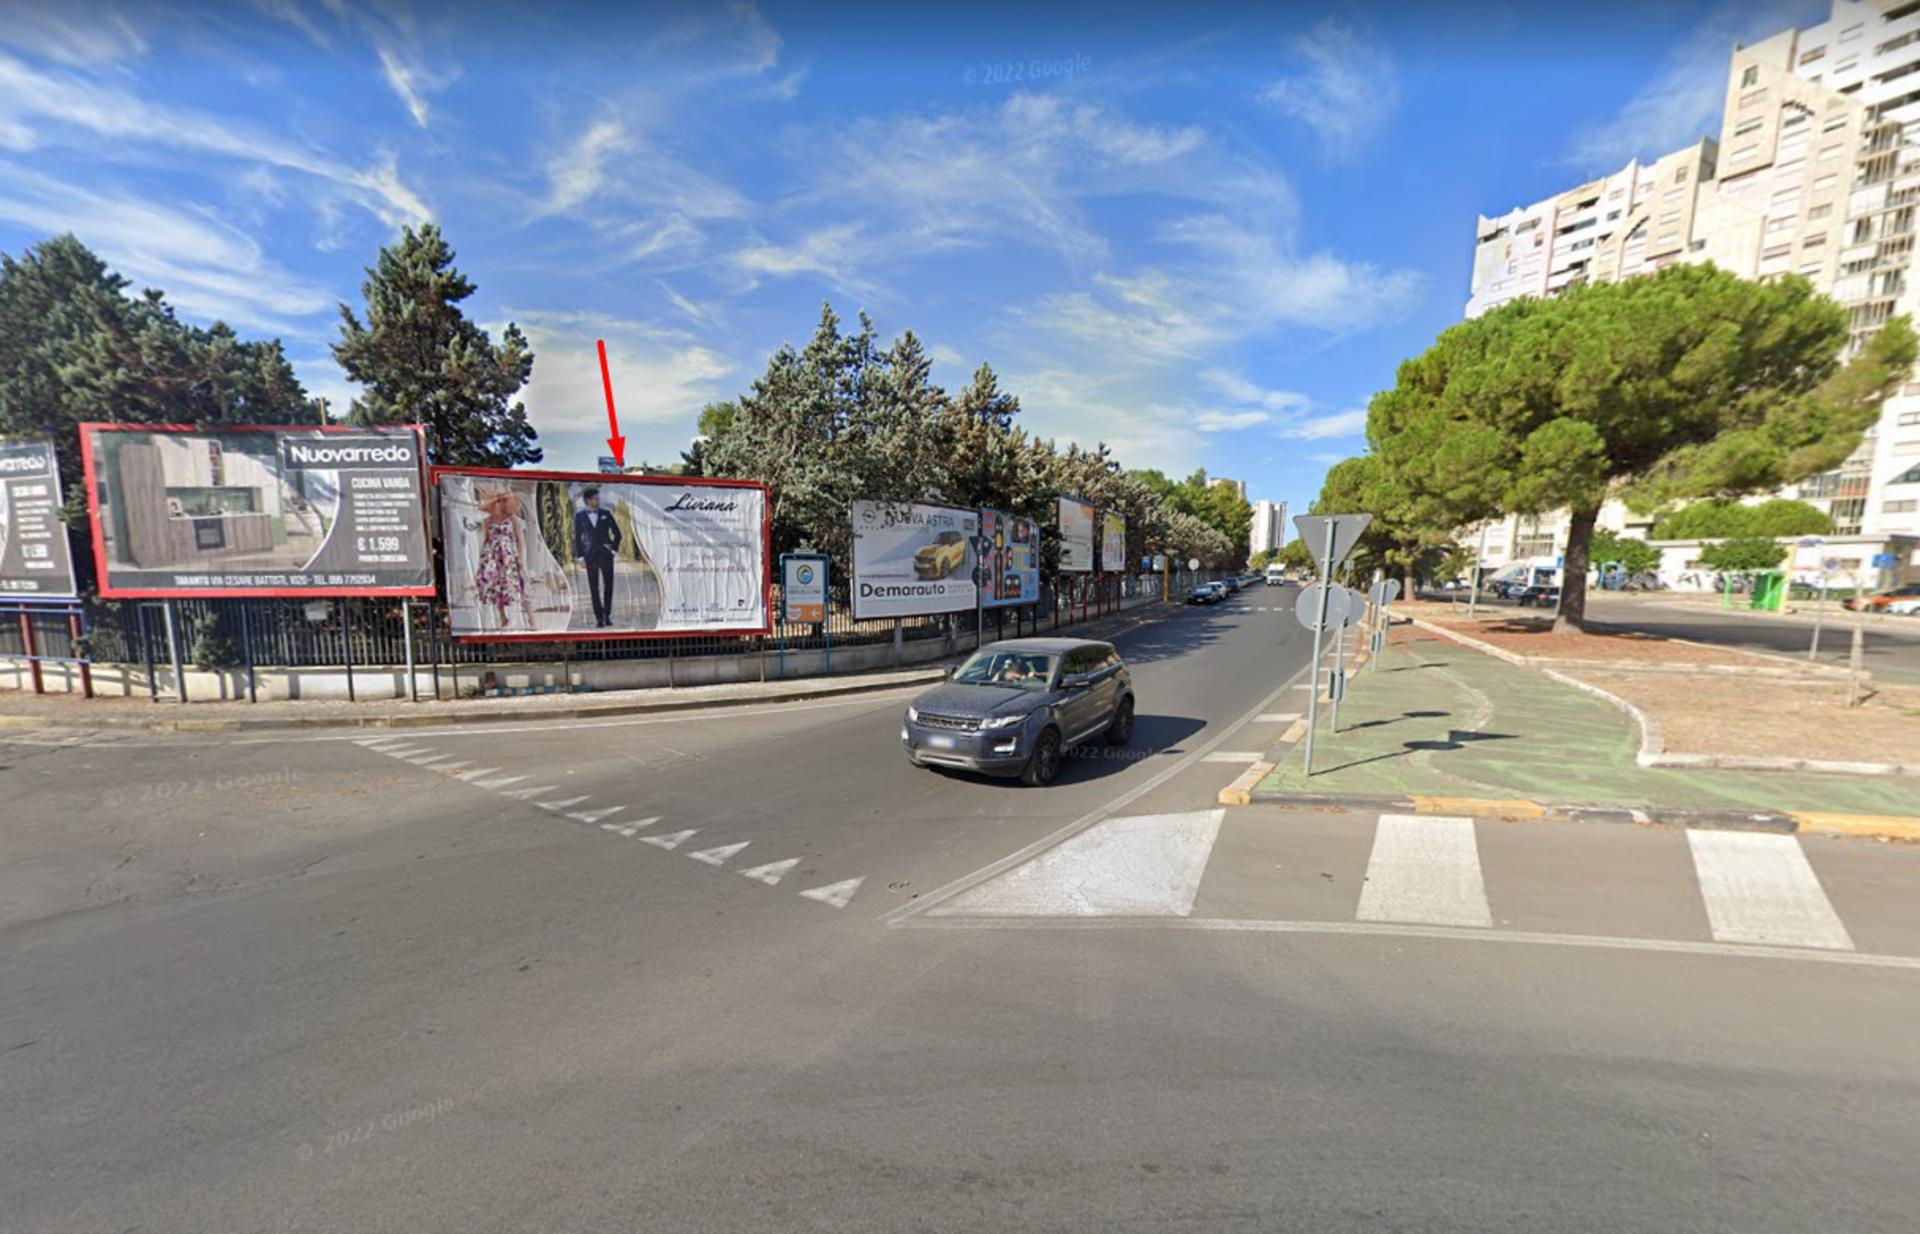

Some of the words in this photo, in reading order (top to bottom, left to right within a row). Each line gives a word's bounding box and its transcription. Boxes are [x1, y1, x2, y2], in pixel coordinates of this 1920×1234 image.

[290, 445, 411, 464] Nuovarredo
[0, 455, 46, 471] arredo
[664, 493, 738, 512] Liviana
[926, 513, 954, 527] ASTRA
[368, 537, 400, 551] 1.599
[859, 583, 945, 598] Demarauto
